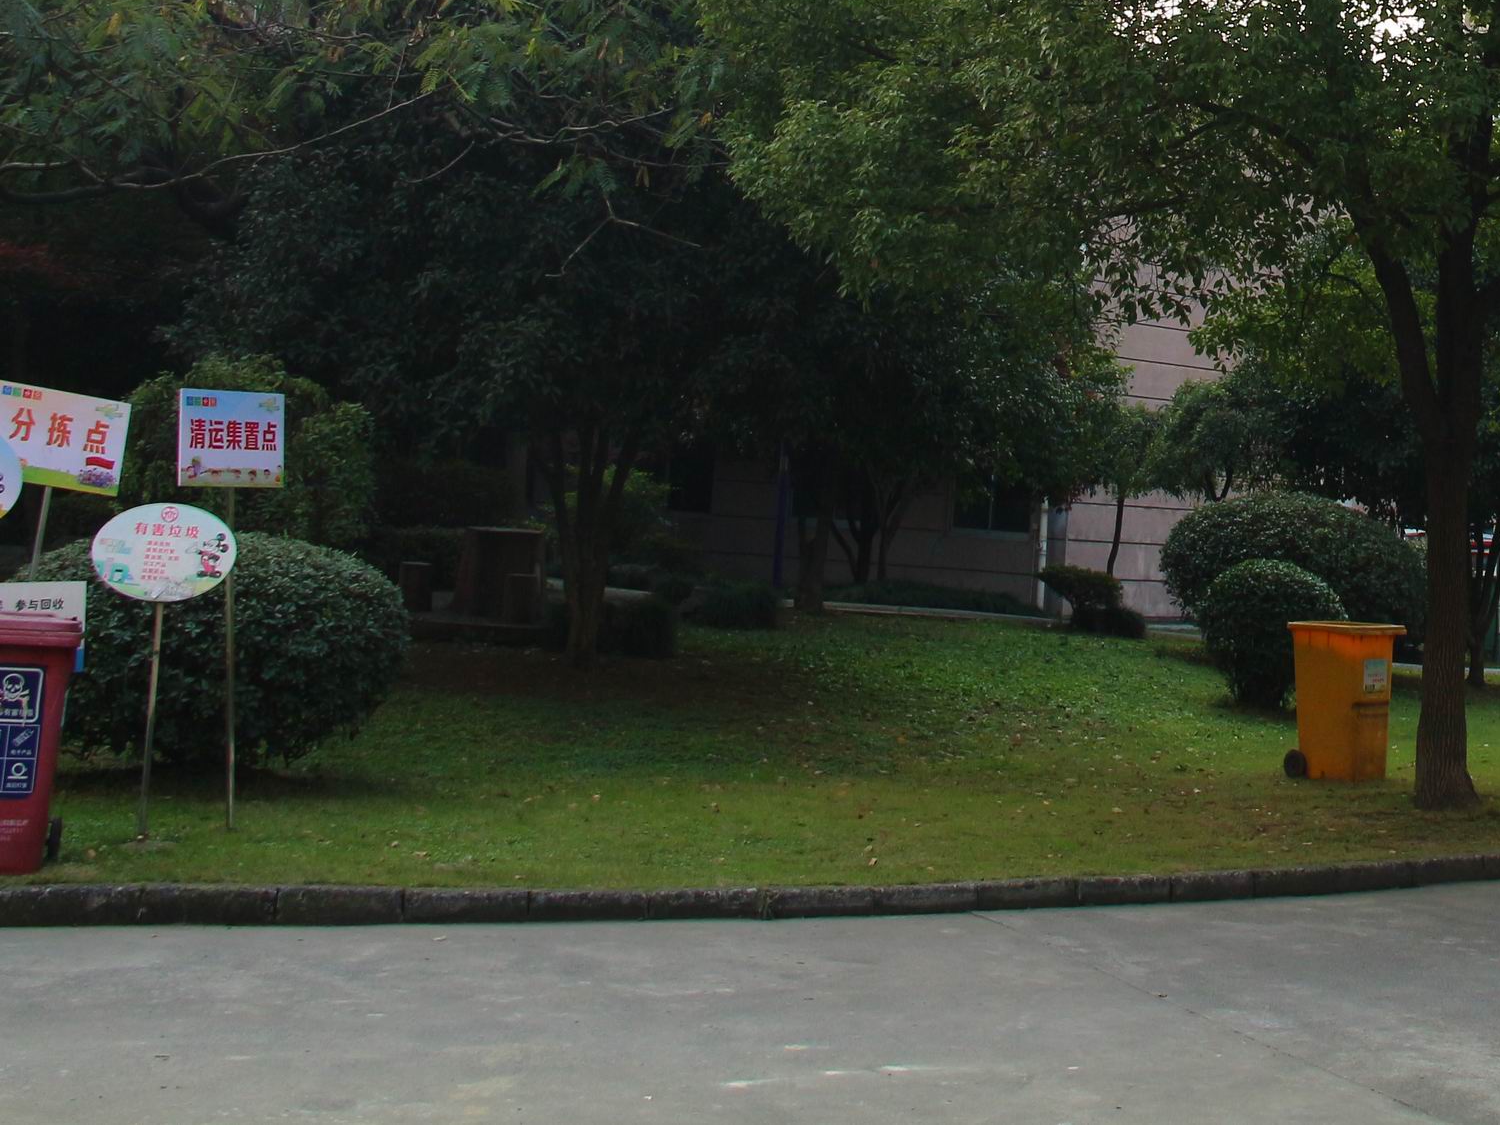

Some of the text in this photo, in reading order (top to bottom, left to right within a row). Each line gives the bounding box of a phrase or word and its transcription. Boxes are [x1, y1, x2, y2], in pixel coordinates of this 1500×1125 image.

[9, 407, 110, 455] 分拣点
[189, 418, 277, 452] 清运集置点
[134, 522, 199, 539] 有害垃圾
[15, 598, 65, 611] 参与回收
